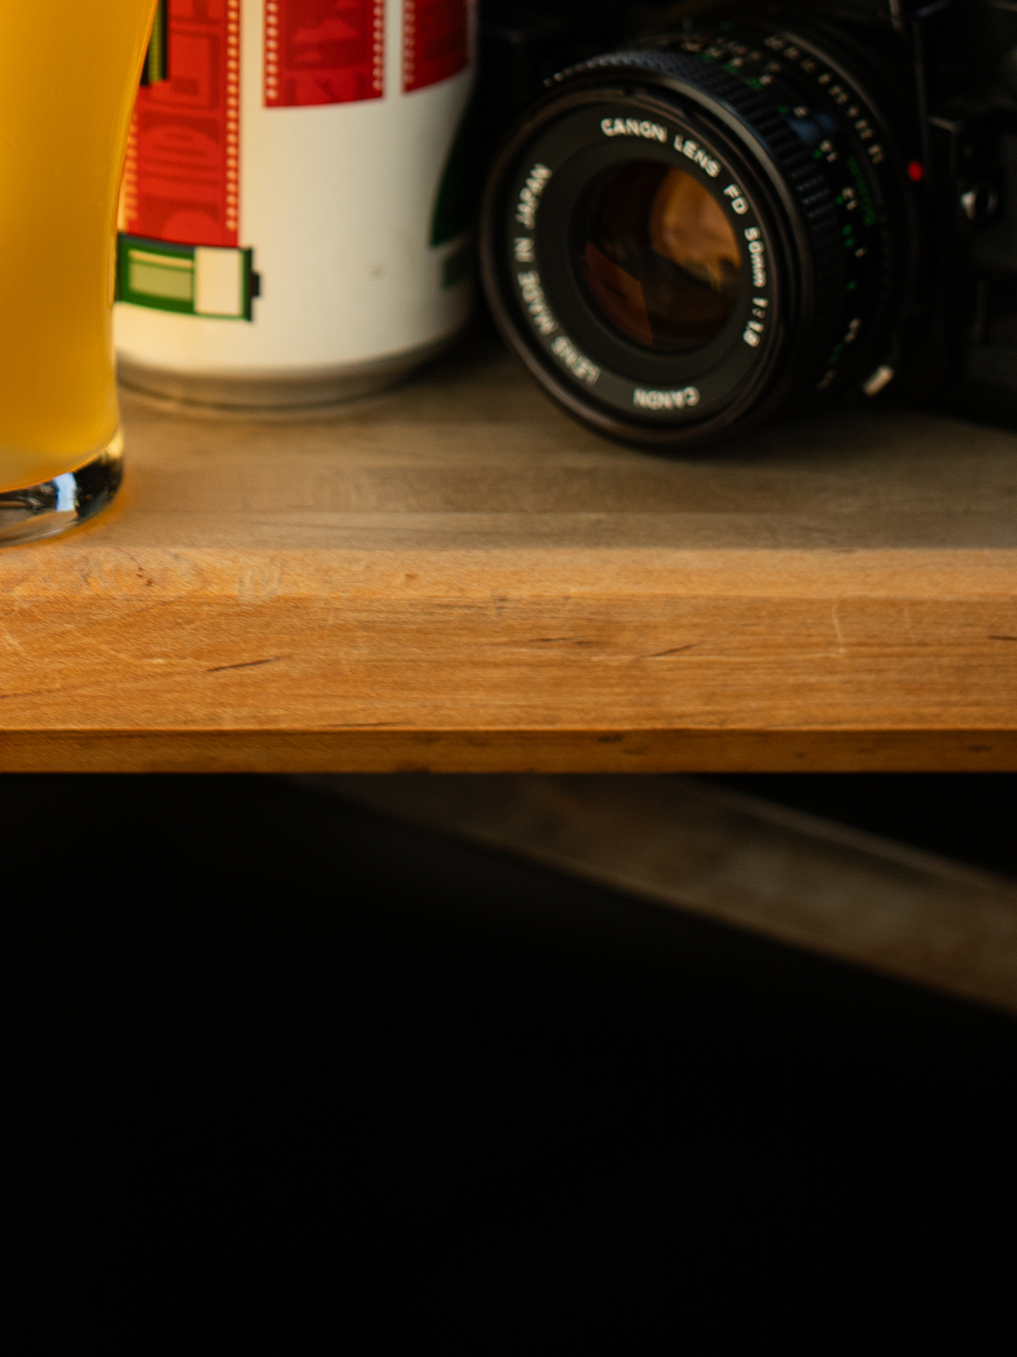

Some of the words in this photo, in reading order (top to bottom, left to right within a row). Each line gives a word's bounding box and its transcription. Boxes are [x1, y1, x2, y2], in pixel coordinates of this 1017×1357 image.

[515, 162, 553, 230] JAPAN
[600, 117, 668, 143] CANON
[673, 134, 721, 178] LENS
[723, 184, 749, 215] FD
[744, 226, 767, 288] 50mm
[514, 236, 535, 263] IN
[516, 270, 557, 336] MADE
[550, 335, 602, 385] LENS
[632, 385, 701, 411] CANON
